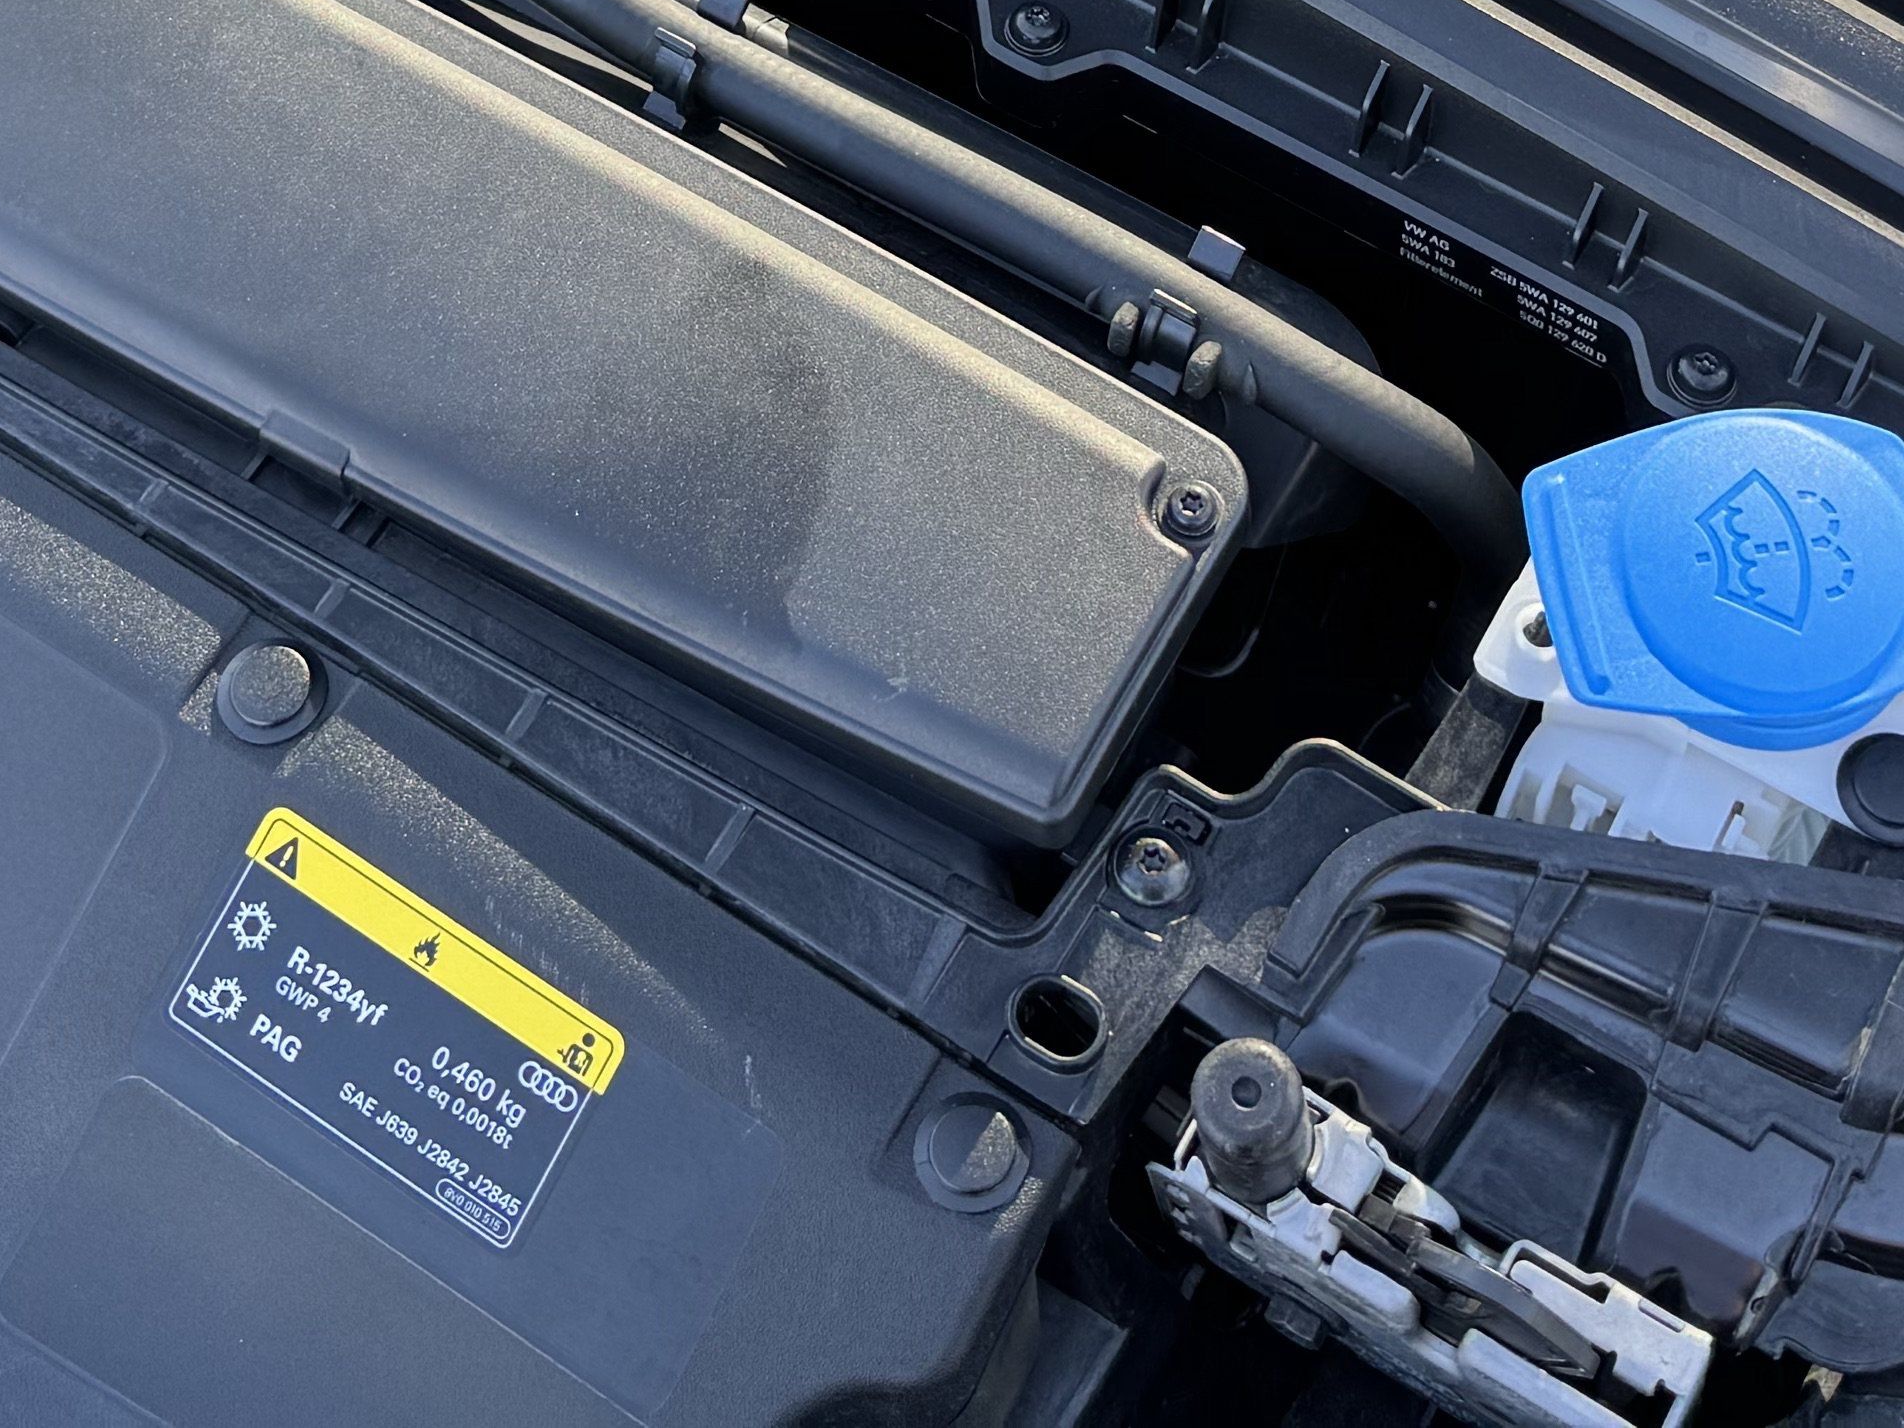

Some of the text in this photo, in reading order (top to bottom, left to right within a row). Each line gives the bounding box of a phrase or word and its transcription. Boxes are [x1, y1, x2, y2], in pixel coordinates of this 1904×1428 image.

[1401, 233, 1430, 256] 5WA
[1403, 219, 1450, 252] VW AG
[1516, 294, 1598, 343] 5WA 129 607
[1519, 280, 1549, 304] 5WA
[1553, 298, 1575, 316] 129
[1576, 311, 1599, 330] 601
[1547, 324, 1569, 343] 129
[274, 975, 331, 1024] GWP 4
[286, 945, 390, 1027] R-1234yf
[249, 1013, 304, 1064] PAG
[431, 1045, 528, 1129] 0,460 kg
[427, 1081, 451, 1110] eq
[451, 1096, 515, 1150] 0,0018t
[338, 1082, 523, 1217] SAE J639 J2842 J2845
[463, 1200, 483, 1218] 010
[481, 1212, 502, 1232] 515
